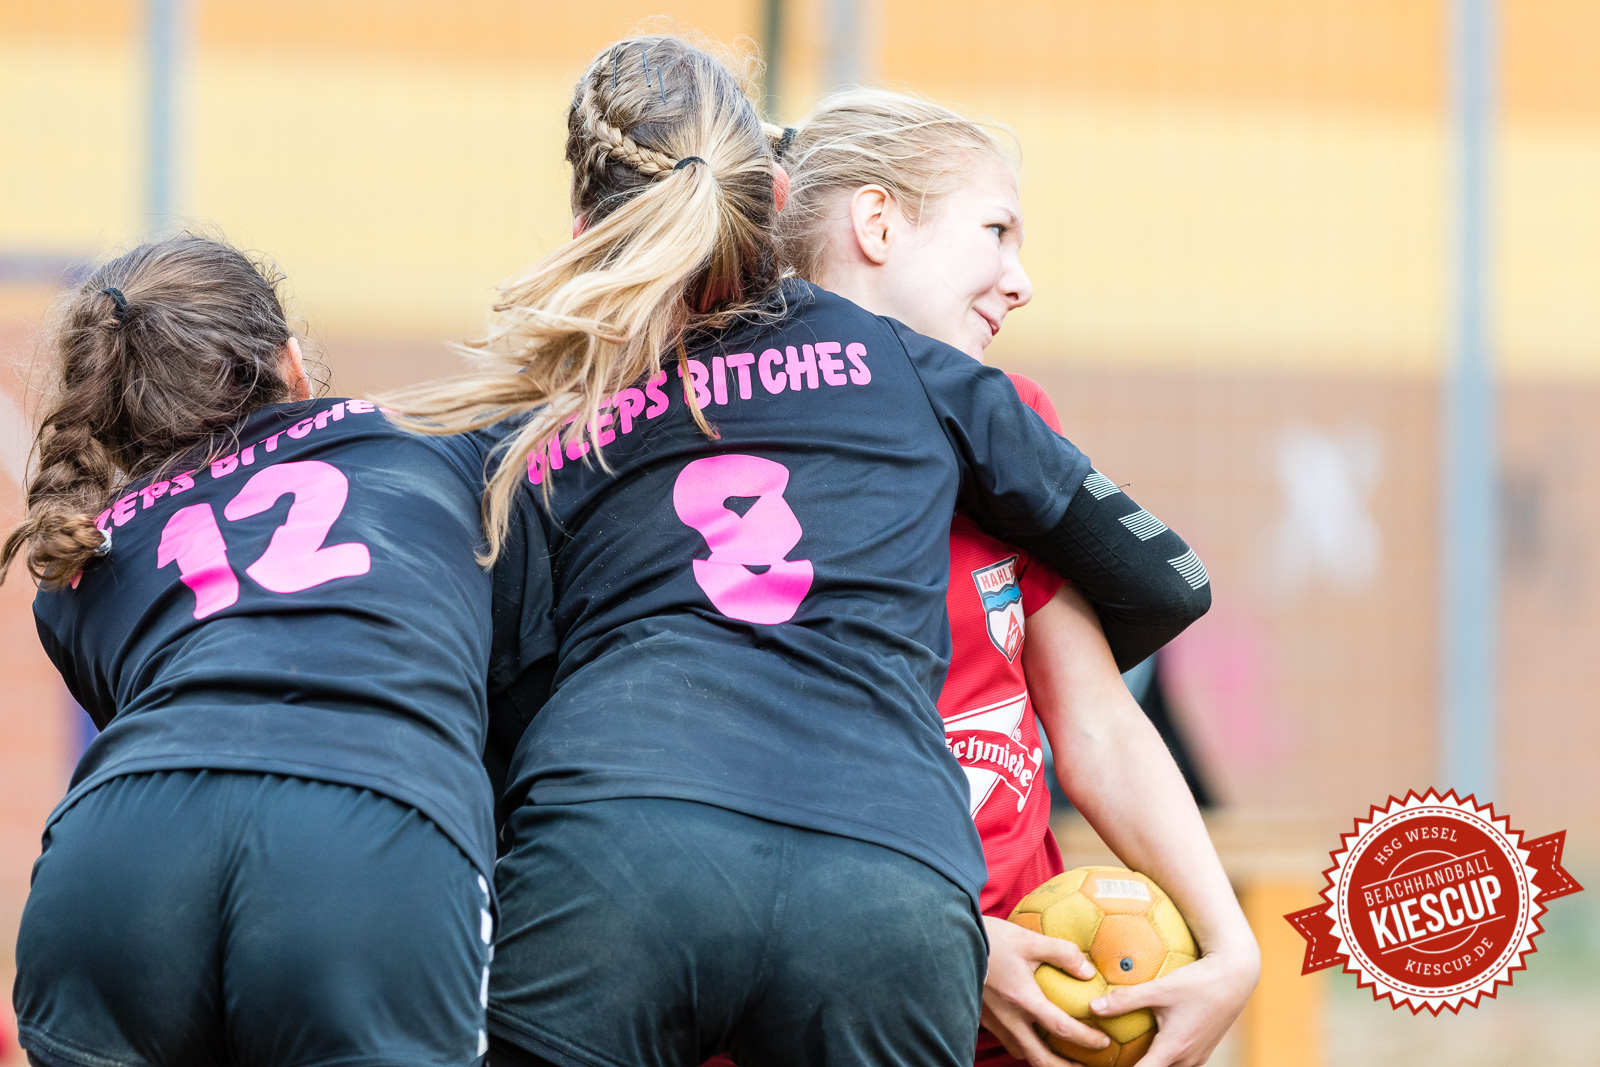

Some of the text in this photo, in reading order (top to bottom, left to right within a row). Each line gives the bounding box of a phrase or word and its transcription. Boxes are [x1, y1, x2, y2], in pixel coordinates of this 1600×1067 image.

[677, 341, 872, 410] BITCHES
[157, 460, 371, 620] 12
[673, 454, 814, 625] 8
